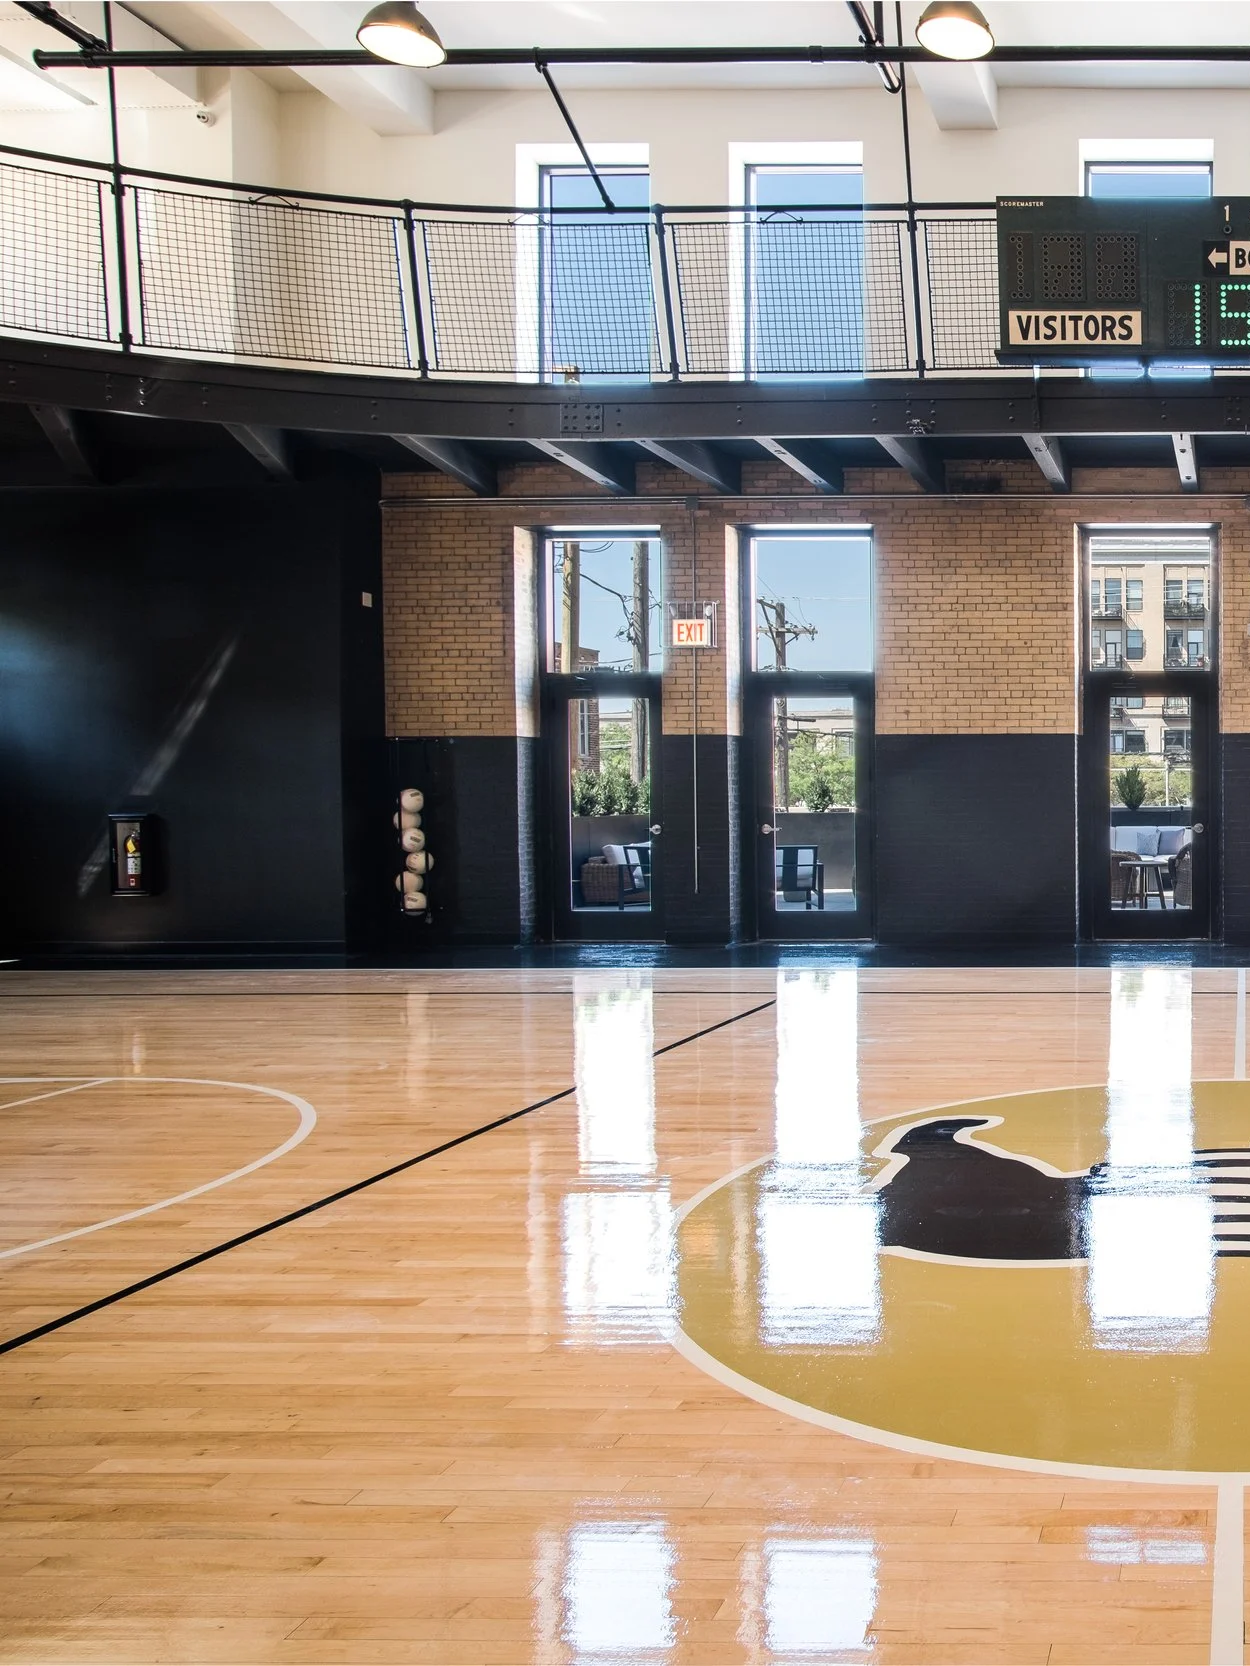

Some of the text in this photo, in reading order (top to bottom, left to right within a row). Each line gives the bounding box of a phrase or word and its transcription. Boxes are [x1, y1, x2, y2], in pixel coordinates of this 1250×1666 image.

[1224, 205, 1230, 222] 1
[1017, 315, 1133, 341] VISITORS
[677, 623, 704, 642] EXIT
